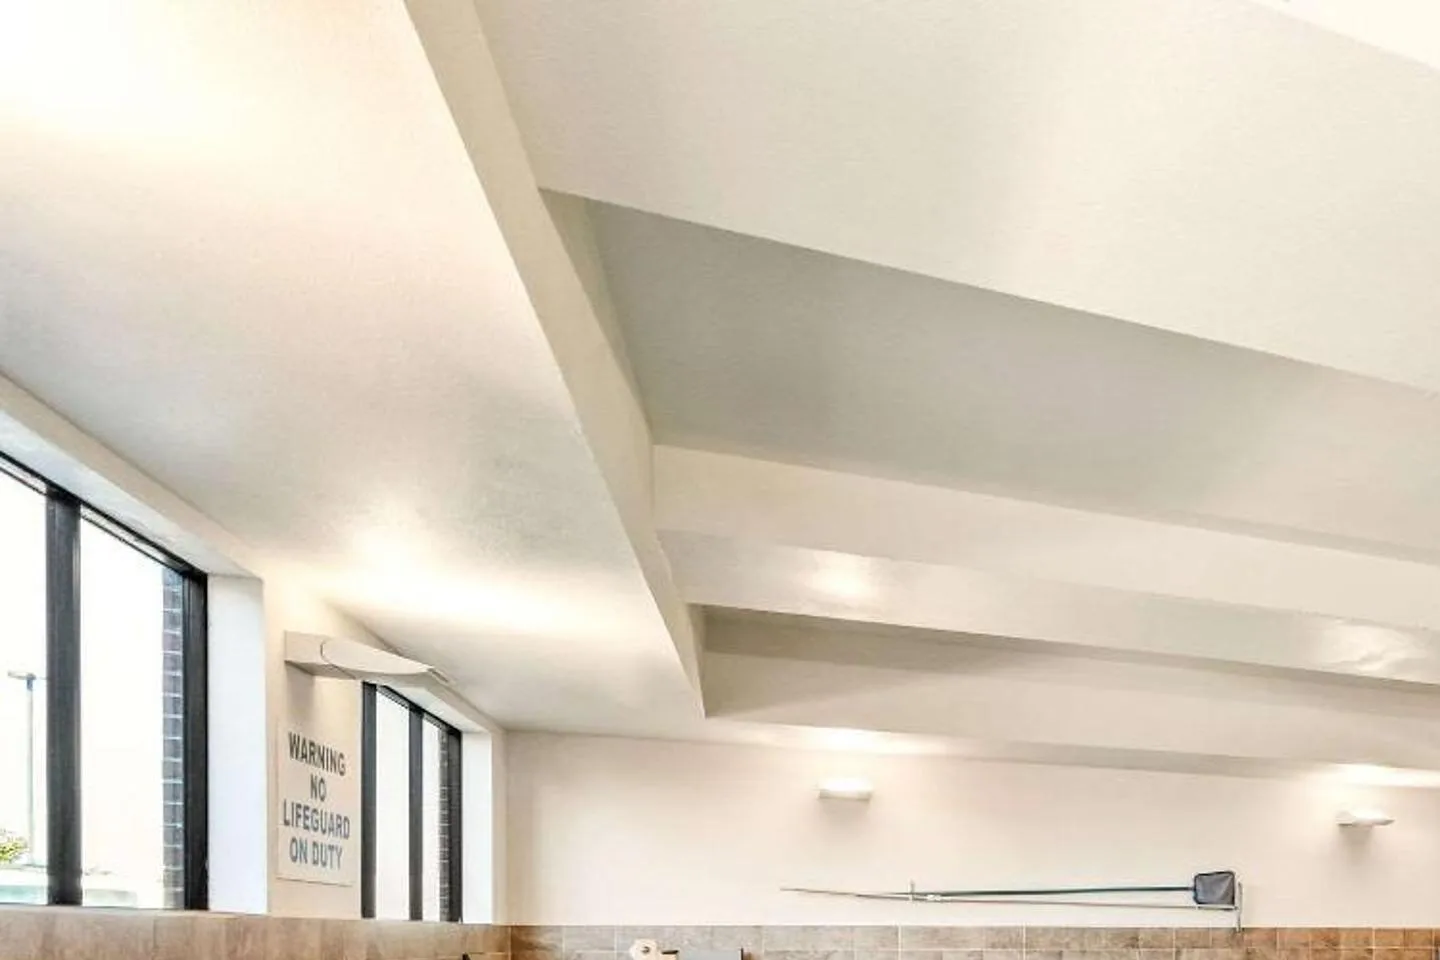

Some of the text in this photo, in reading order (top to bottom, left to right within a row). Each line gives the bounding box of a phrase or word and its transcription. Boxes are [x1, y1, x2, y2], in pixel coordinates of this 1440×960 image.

[288, 731, 346, 776] WARNING
[310, 774, 327, 802] NO
[283, 799, 350, 840] LIFEGUARD
[289, 837, 343, 870] ON DUTY
